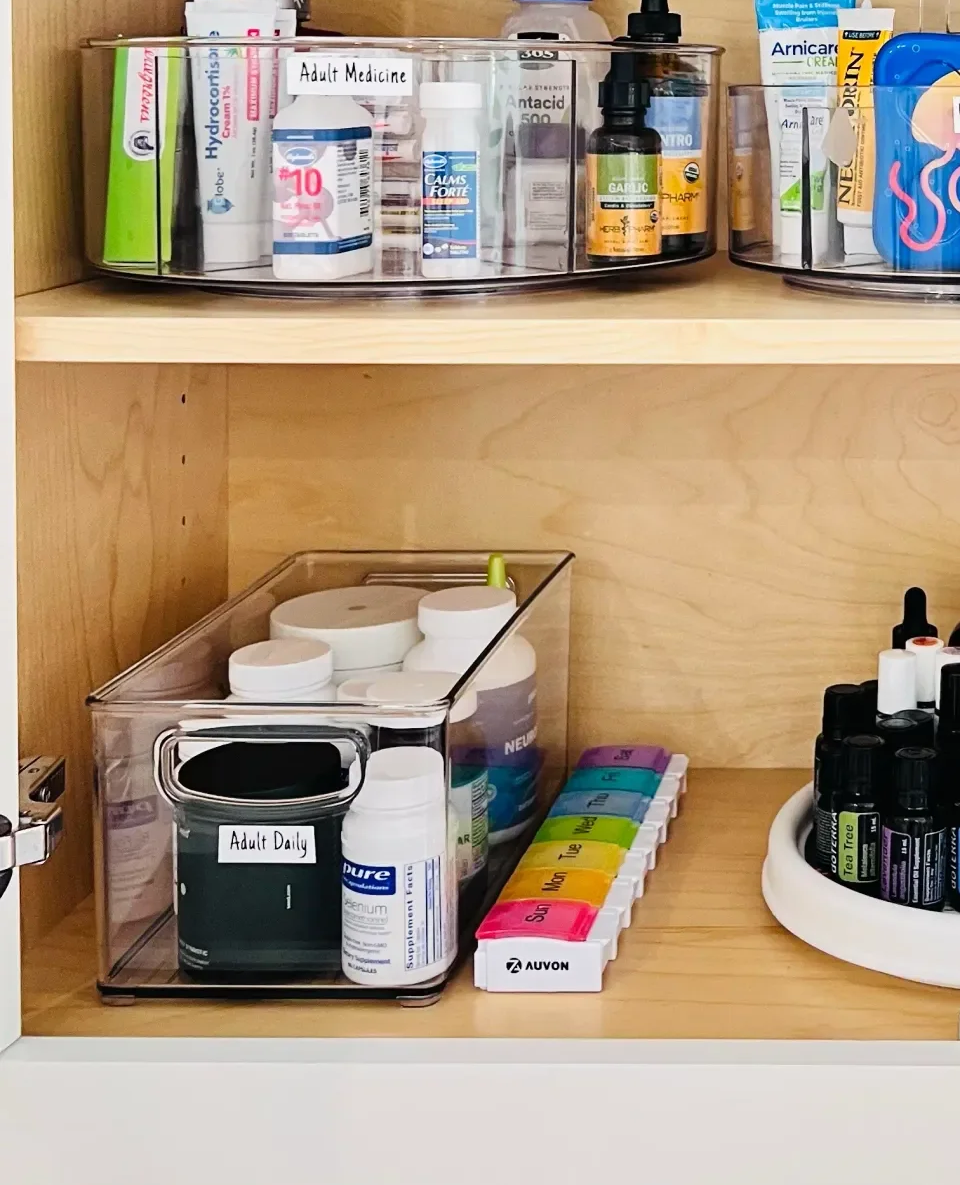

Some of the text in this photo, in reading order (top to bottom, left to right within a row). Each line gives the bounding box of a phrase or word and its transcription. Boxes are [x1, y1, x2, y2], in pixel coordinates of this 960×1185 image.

[806, 56, 838, 68] CREA
[300, 62, 407, 84] Adult Medicine
[505, 94, 566, 110] Antacid
[221, 85, 232, 139] Cream 1%
[520, 113, 552, 125] 500
[781, 115, 823, 130] Arnare
[838, 50, 865, 206] NEORIN
[660, 134, 694, 147] NTRO
[279, 166, 323, 197] #10
[424, 173, 468, 186] CALMS
[608, 182, 649, 193] GARLIC
[430, 183, 470, 198] FORTÉ
[601, 771, 621, 782] Fri
[587, 792, 609, 809] Thu
[572, 816, 598, 835] Wed
[230, 830, 307, 858] Adult Daily
[457, 834, 470, 845] AR
[558, 842, 582, 861] Tue
[843, 824, 854, 876] Tea Tree
[342, 862, 391, 882] pure
[541, 871, 568, 892] Mon
[405, 865, 414, 969] Supplement Facts
[525, 903, 552, 923] Sun
